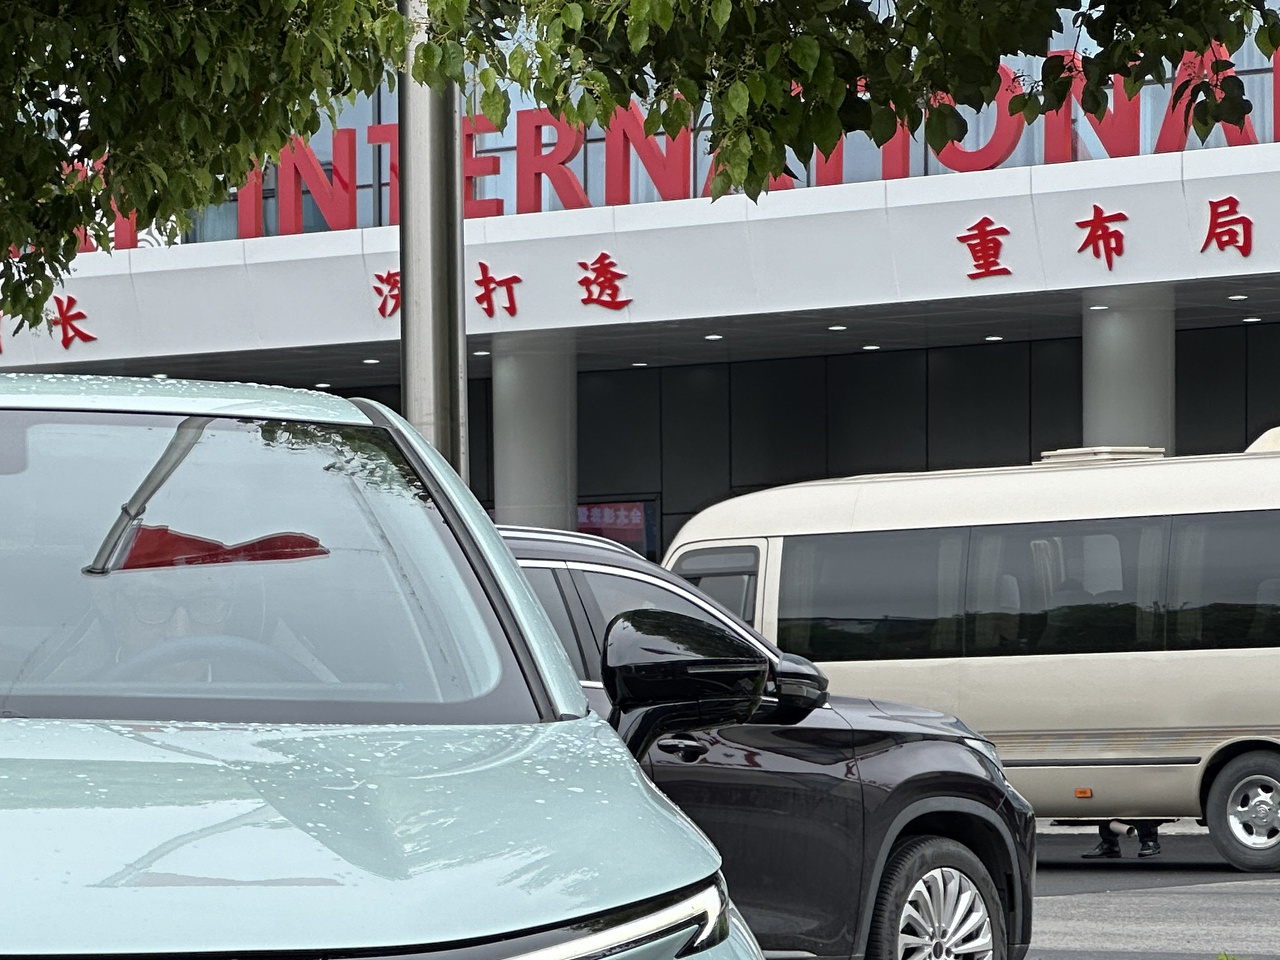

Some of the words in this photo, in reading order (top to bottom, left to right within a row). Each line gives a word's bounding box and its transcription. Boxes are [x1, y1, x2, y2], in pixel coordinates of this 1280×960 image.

[237, 44, 1280, 239] INTERNIONA
[957, 196, 1255, 281] 重布局
